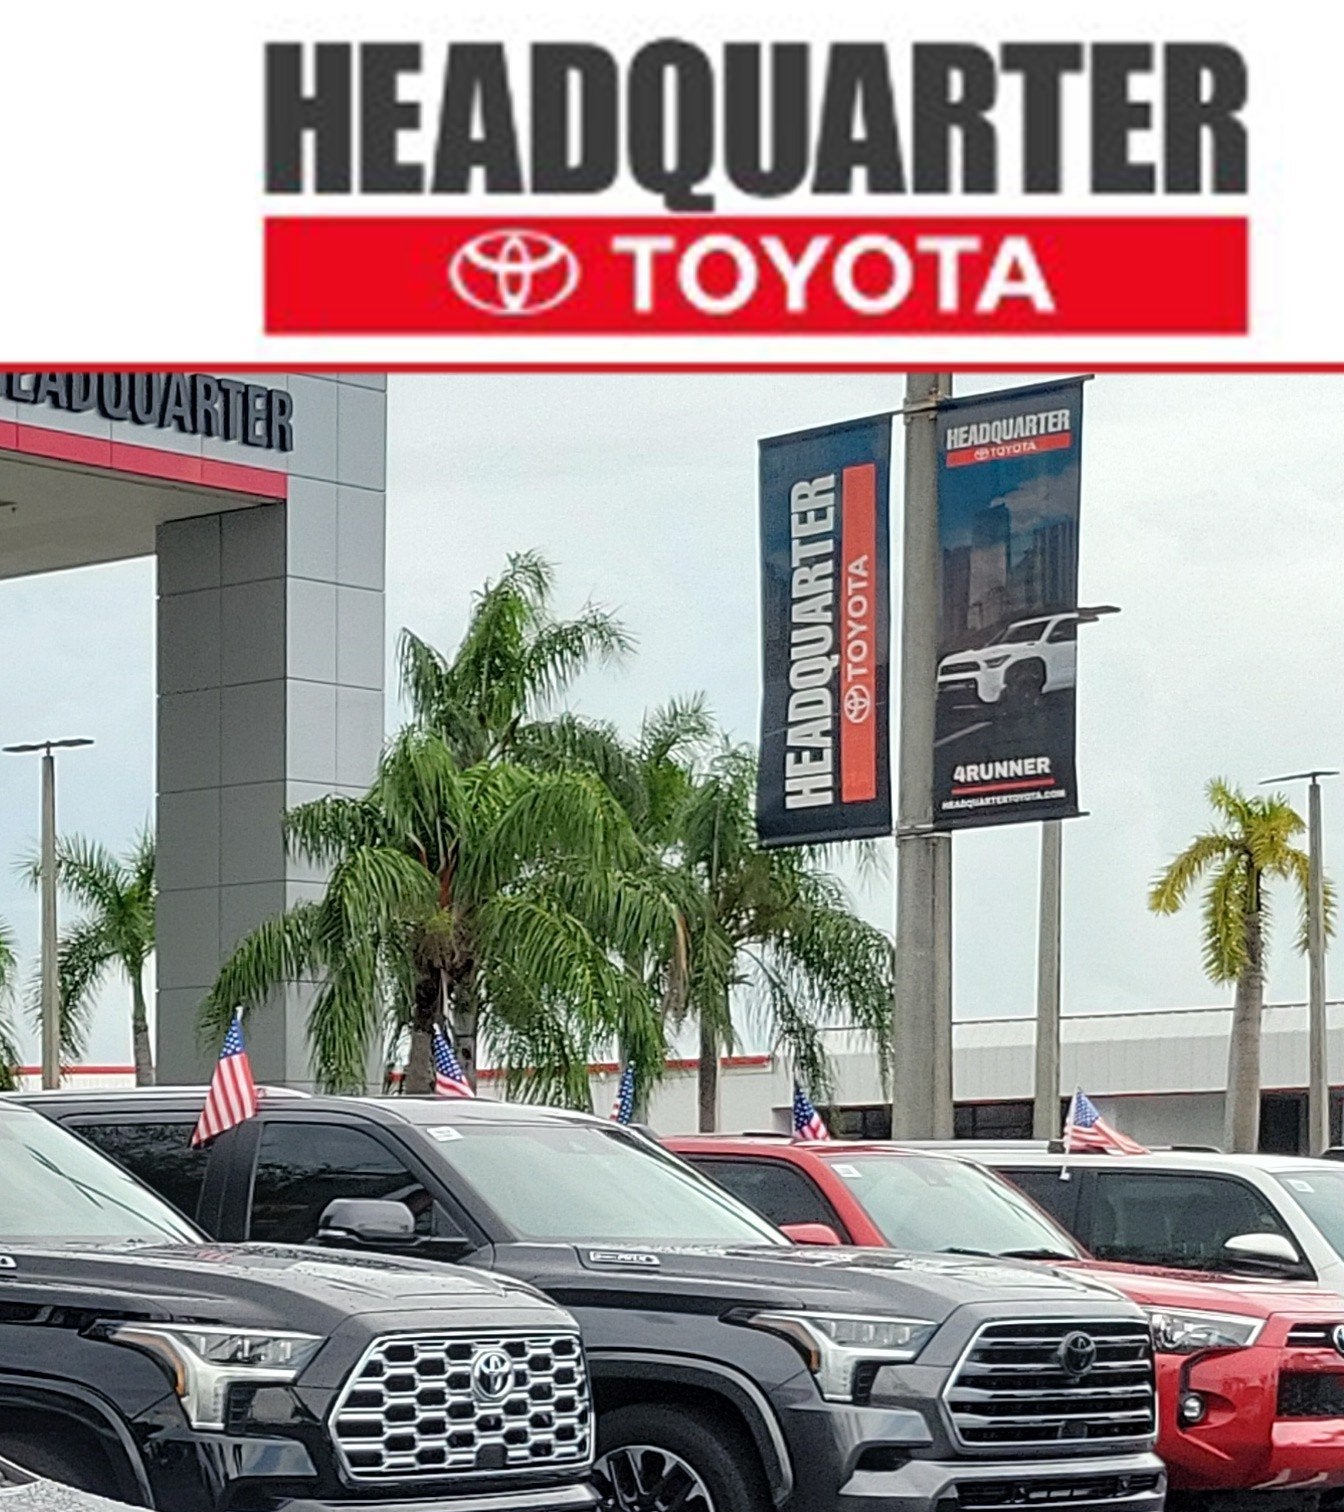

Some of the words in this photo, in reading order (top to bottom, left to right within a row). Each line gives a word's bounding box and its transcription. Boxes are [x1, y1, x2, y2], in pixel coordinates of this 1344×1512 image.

[947, 408, 1070, 450] HEADQUARTER
[991, 441, 1037, 457] TOYOTA
[846, 554, 869, 682] TOYOTA
[785, 473, 840, 810] HEADQUARTER
[953, 757, 1051, 783] 4RUNNER
